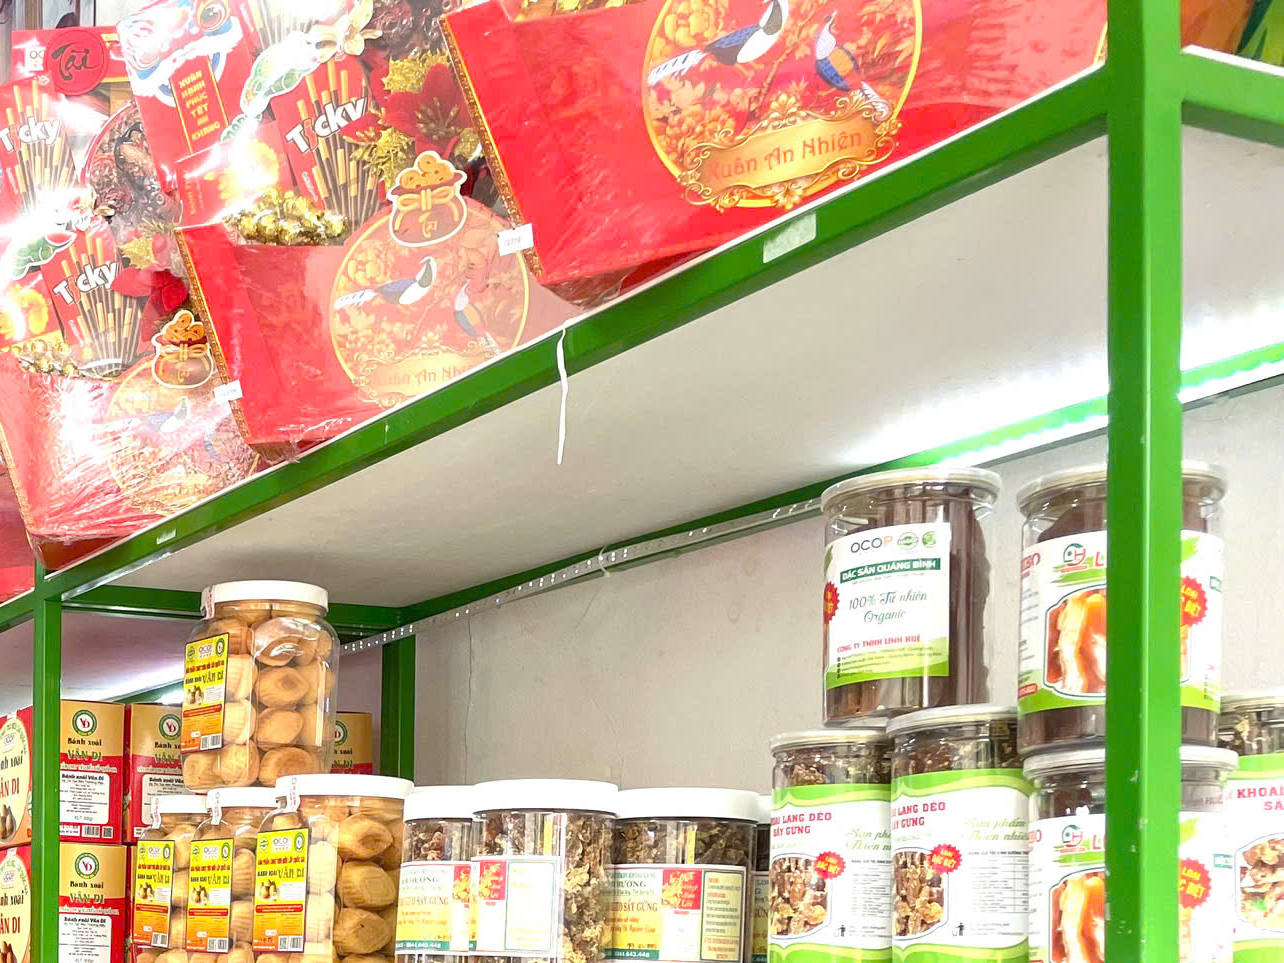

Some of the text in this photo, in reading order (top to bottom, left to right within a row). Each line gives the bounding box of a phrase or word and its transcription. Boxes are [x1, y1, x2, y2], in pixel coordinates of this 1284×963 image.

[764, 146, 795, 170] An
[851, 535, 892, 553] OCOP
[864, 609, 906, 624] Organic
[68, 748, 89, 761] VÂN
[12, 778, 20, 795] DI
[898, 804, 919, 816] LANG
[783, 813, 805, 824] LANG
